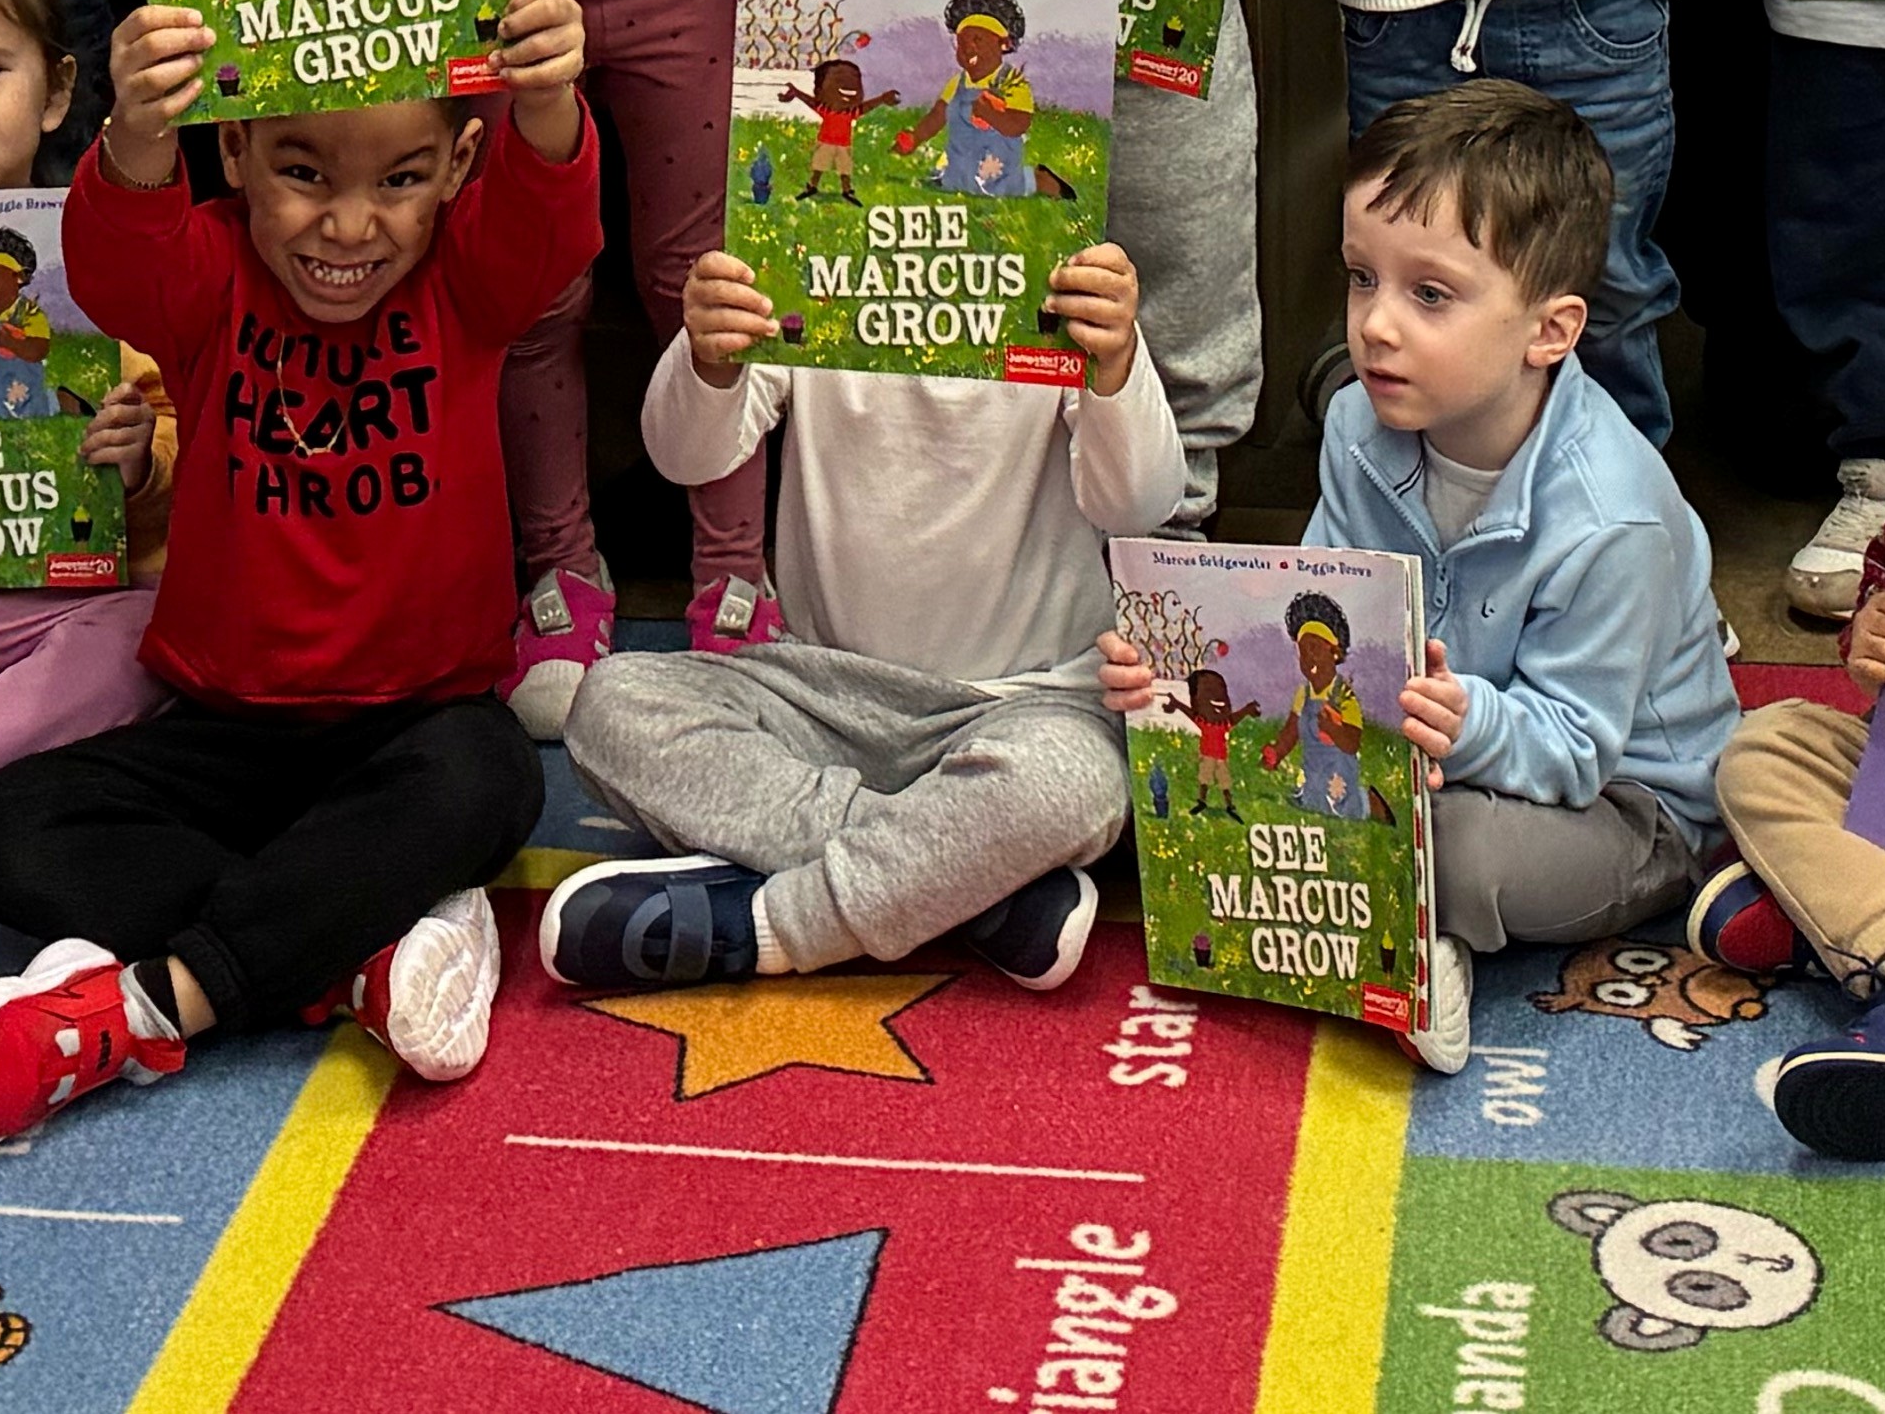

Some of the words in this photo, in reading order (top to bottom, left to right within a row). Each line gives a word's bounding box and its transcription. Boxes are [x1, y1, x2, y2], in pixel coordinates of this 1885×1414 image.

[294, 20, 442, 83] GROW
[869, 205, 968, 248] SEE
[809, 253, 1026, 297] MARCUS
[858, 302, 1006, 348] GROW
[225, 366, 438, 459] HEART
[1250, 824, 1327, 872] SEE
[1208, 874, 1371, 928] MARCUS
[1252, 927, 1359, 979] GROW
[1106, 984, 1199, 1089] star
[1469, 1044, 1549, 1128] owl
[987, 1222, 1179, 1414] iangle
[1416, 1281, 1533, 1413] anda
